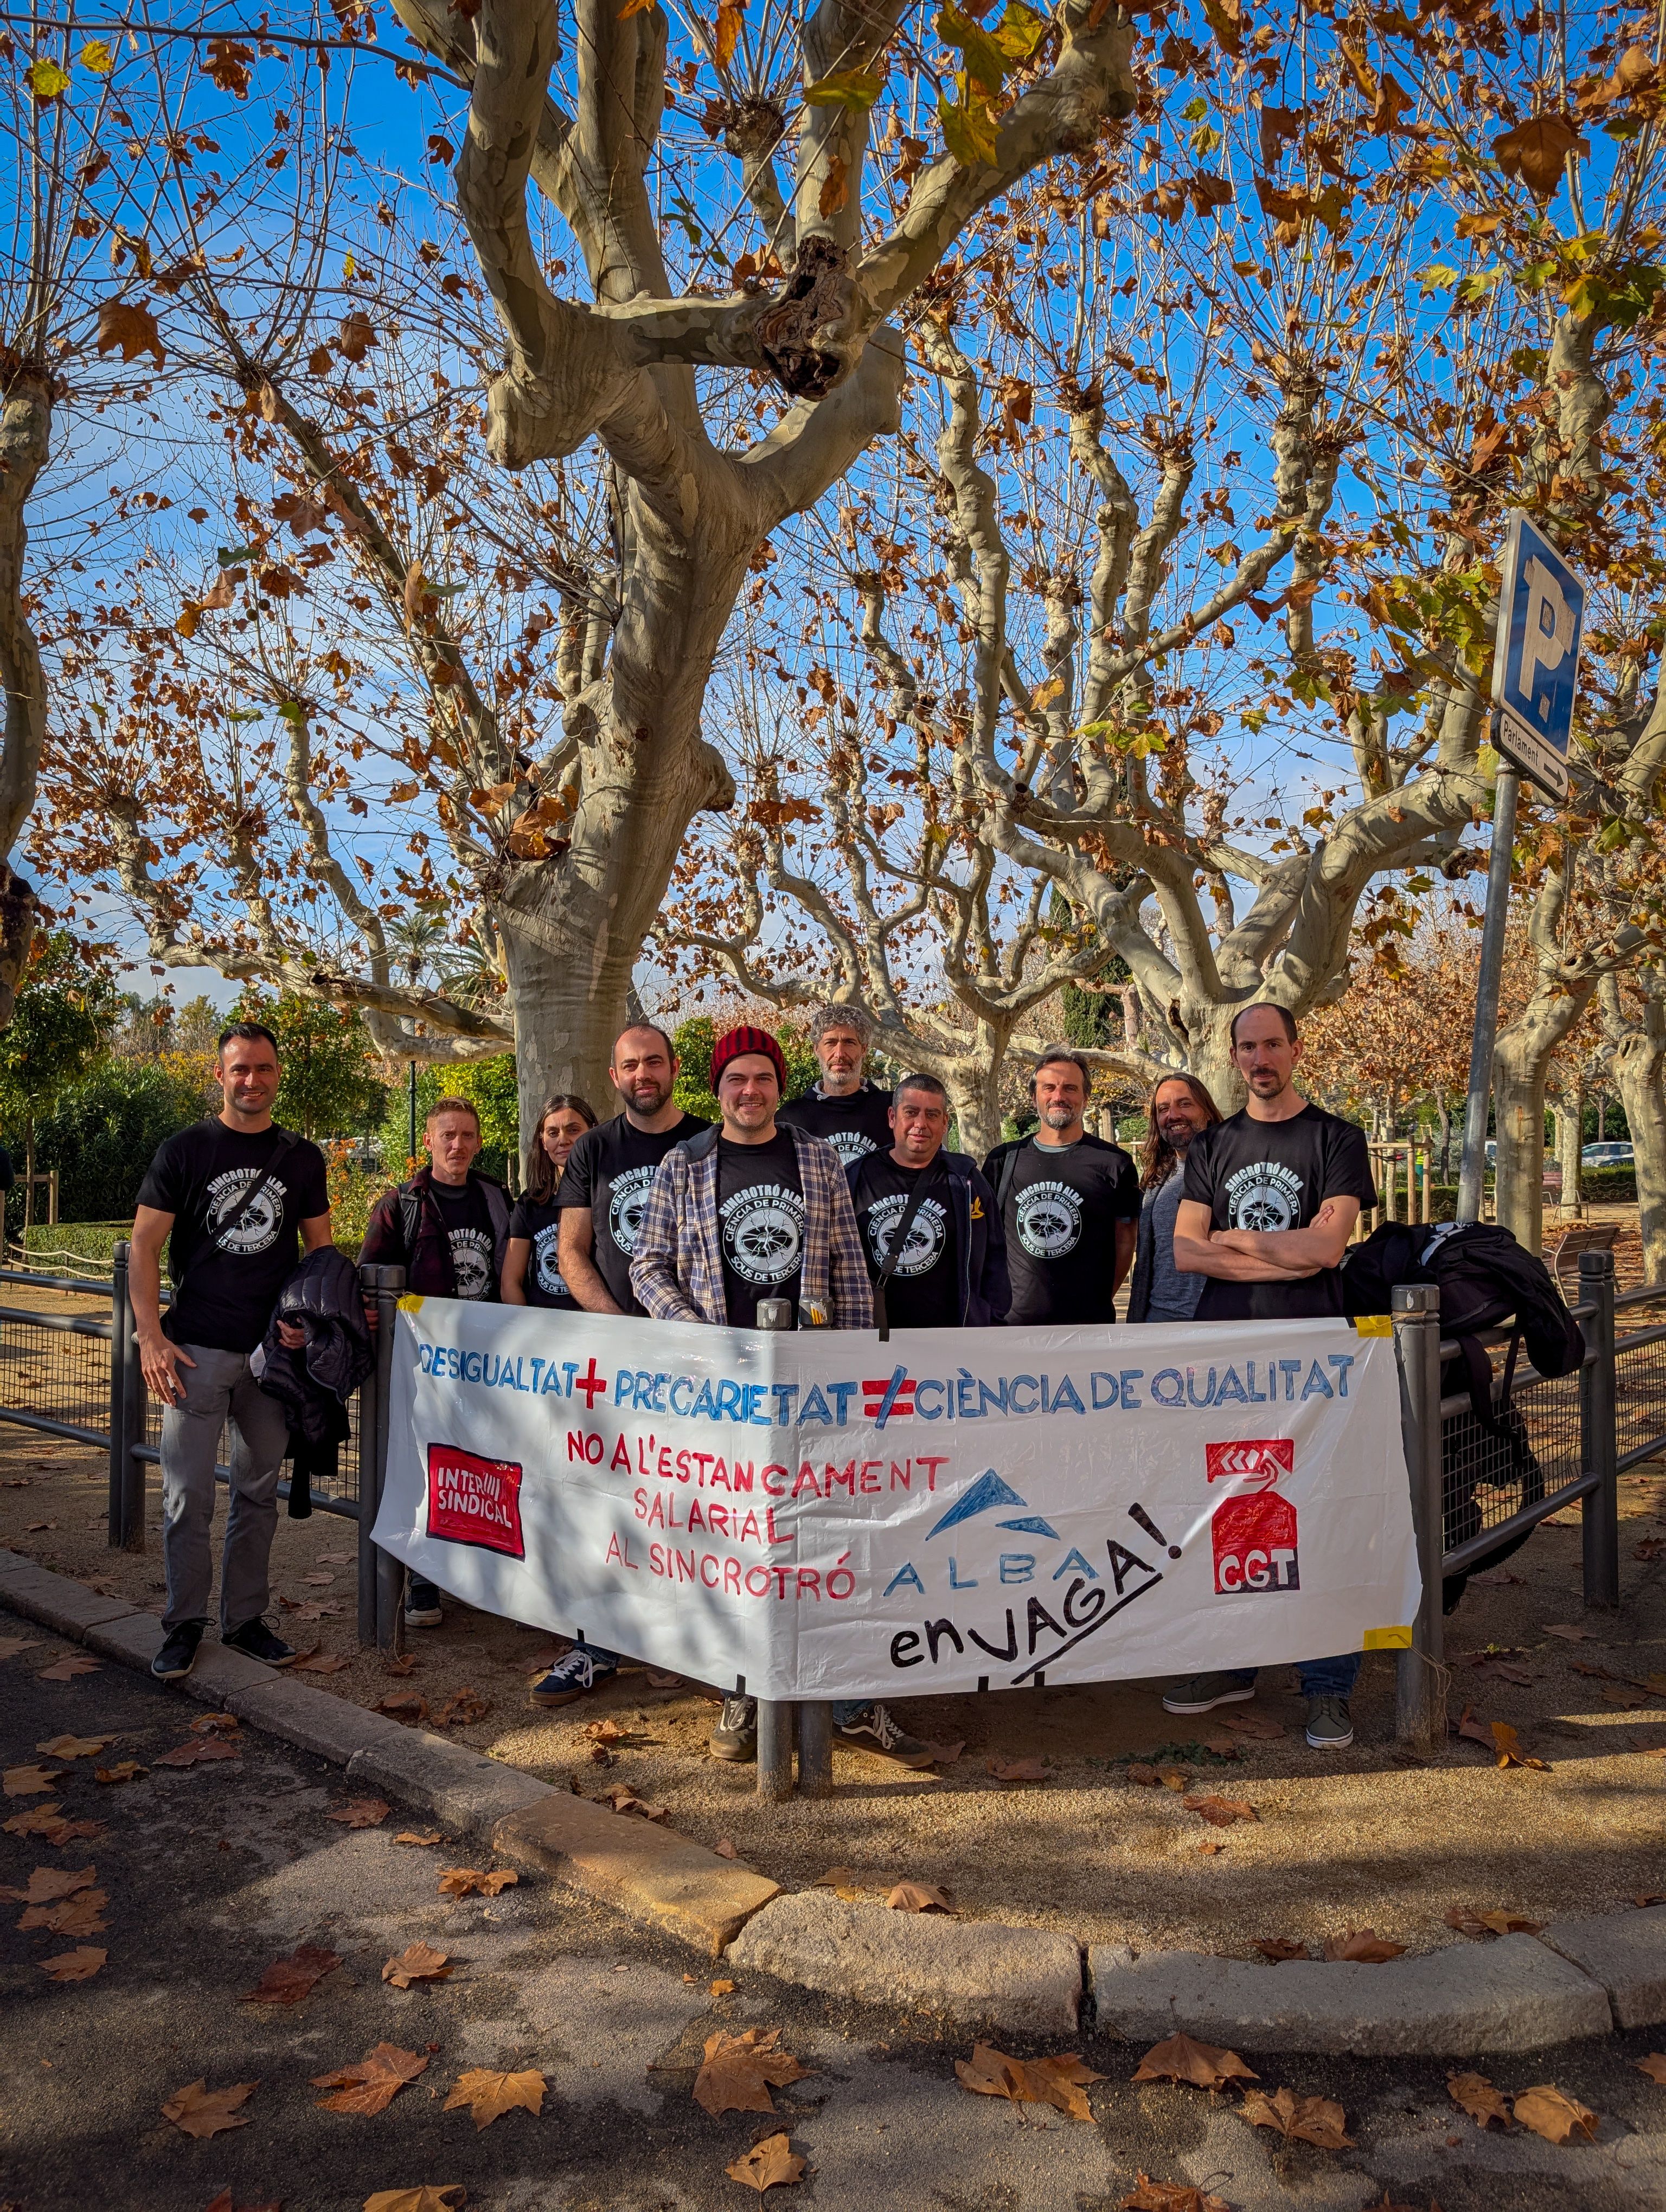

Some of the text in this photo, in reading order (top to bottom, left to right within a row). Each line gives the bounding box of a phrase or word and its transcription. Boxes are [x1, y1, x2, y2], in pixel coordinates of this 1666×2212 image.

[1503, 720, 1539, 767] Parlament
[824, 1131, 860, 1145] ROTRÓ
[860, 1136, 877, 1152] ALB
[608, 1165, 655, 1191] SINCROT
[642, 1179, 651, 1187] D
[1225, 1162, 1304, 1192] SINCROTRÓ ALBA
[239, 1181, 252, 1189] DE
[260, 1186, 281, 1218] RIMERA
[719, 1184, 805, 1218] SINCROTRÓ ALBA
[868, 1194, 947, 1217] SINCROT ALBA
[1015, 1181, 1084, 1207] SINCROTRÓ ALBA
[1255, 1176, 1269, 1185] DE
[1270, 1178, 1299, 1216] PRIMERA
[754, 1199, 770, 1207] DE
[772, 1199, 804, 1236] PRIMERA
[917, 1208, 944, 1239] RIMERA
[1054, 1194, 1080, 1226] PRIMERA
[227, 1242, 241, 1252] DE
[241, 1230, 278, 1252] TERCERA
[448, 1228, 476, 1242] ROTRÓ
[534, 1223, 560, 1242] SINCR
[614, 1229, 633, 1251] SOUS
[1021, 1233, 1035, 1252] SOUS
[1046, 1237, 1077, 1256] TERCERA
[731, 1252, 802, 1282] SOUS DE TERCERA
[905, 1251, 939, 1274] TERCERA
[538, 1271, 549, 1288] SOUS
[548, 1284, 559, 1293] DE
[419, 1343, 579, 1397] DESIGUALTAT
[614, 1370, 857, 1427] PRECARIETAT
[915, 1367, 1087, 1419] CIÈNCIA
[1091, 1369, 1144, 1410] DE
[1150, 1354, 1354, 1409] QUALITAT
[567, 1430, 604, 1465] NO
[611, 1433, 632, 1474] A
[438, 1489, 512, 1529] SINDICAL
[635, 1487, 794, 1545] SALARIAL
[606, 1532, 855, 1602] AL SINCROTRÓ
[883, 1546, 1100, 1597] ALBA
[1219, 1549, 1295, 1592] CGT
